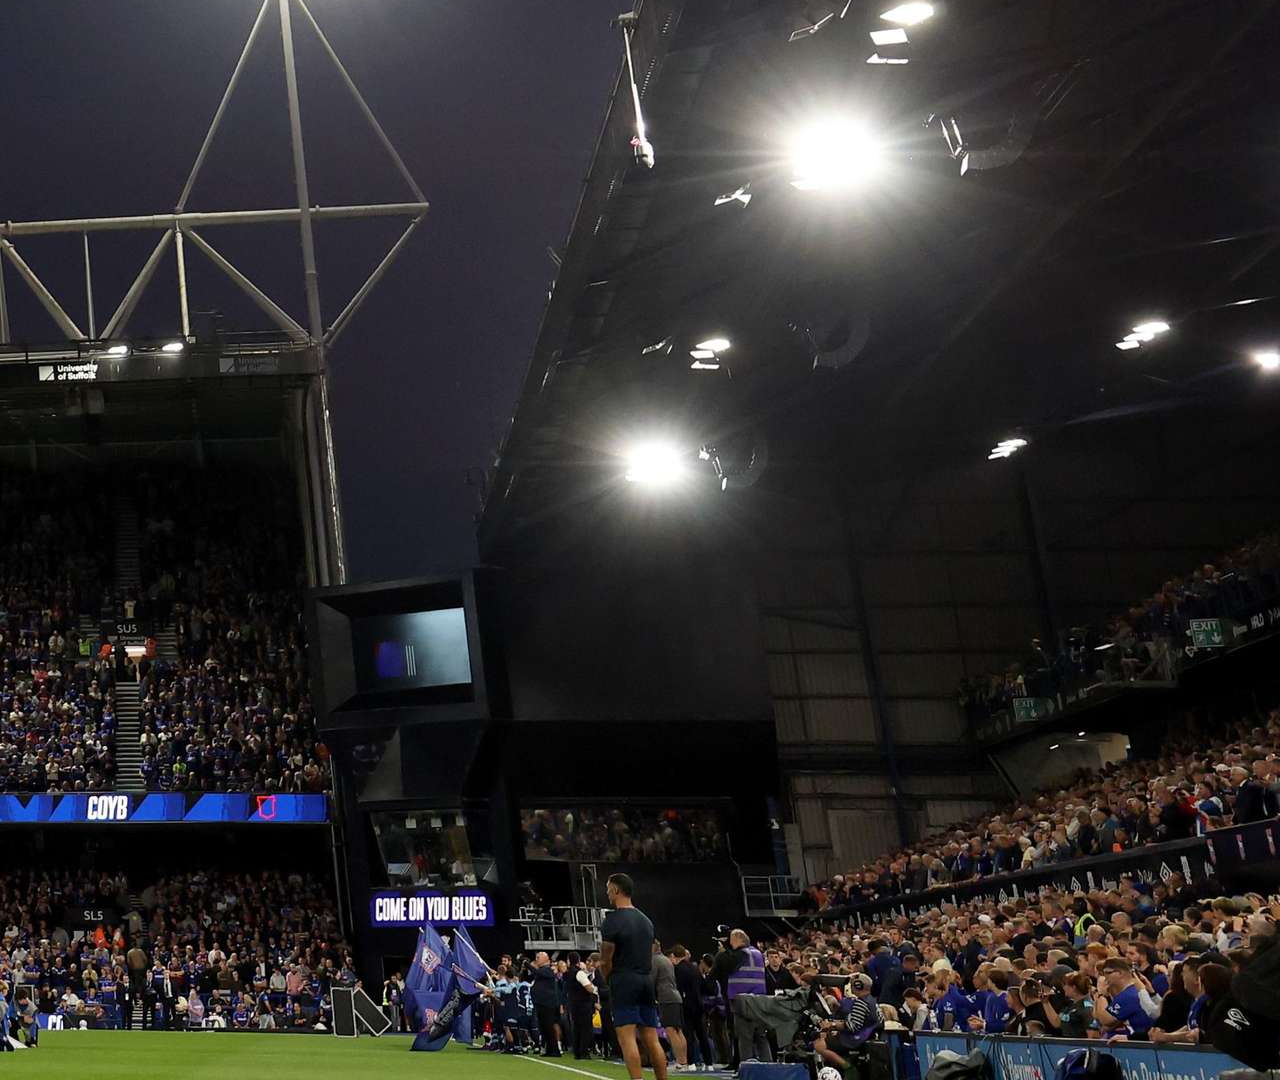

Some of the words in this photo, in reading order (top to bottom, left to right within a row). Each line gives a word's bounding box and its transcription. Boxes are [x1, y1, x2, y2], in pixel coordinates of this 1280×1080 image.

[57, 363, 98, 373] University
[57, 372, 66, 380] of
[68, 371, 96, 380] Suffolk
[116, 624, 137, 633] SU5
[1194, 620, 1219, 631] EXIT
[87, 795, 128, 820] COYB
[375, 898, 407, 921] COME
[408, 897, 425, 921] ON
[426, 897, 449, 920] YOU
[452, 896, 487, 920] BLUES
[83, 910, 104, 920] SL5
